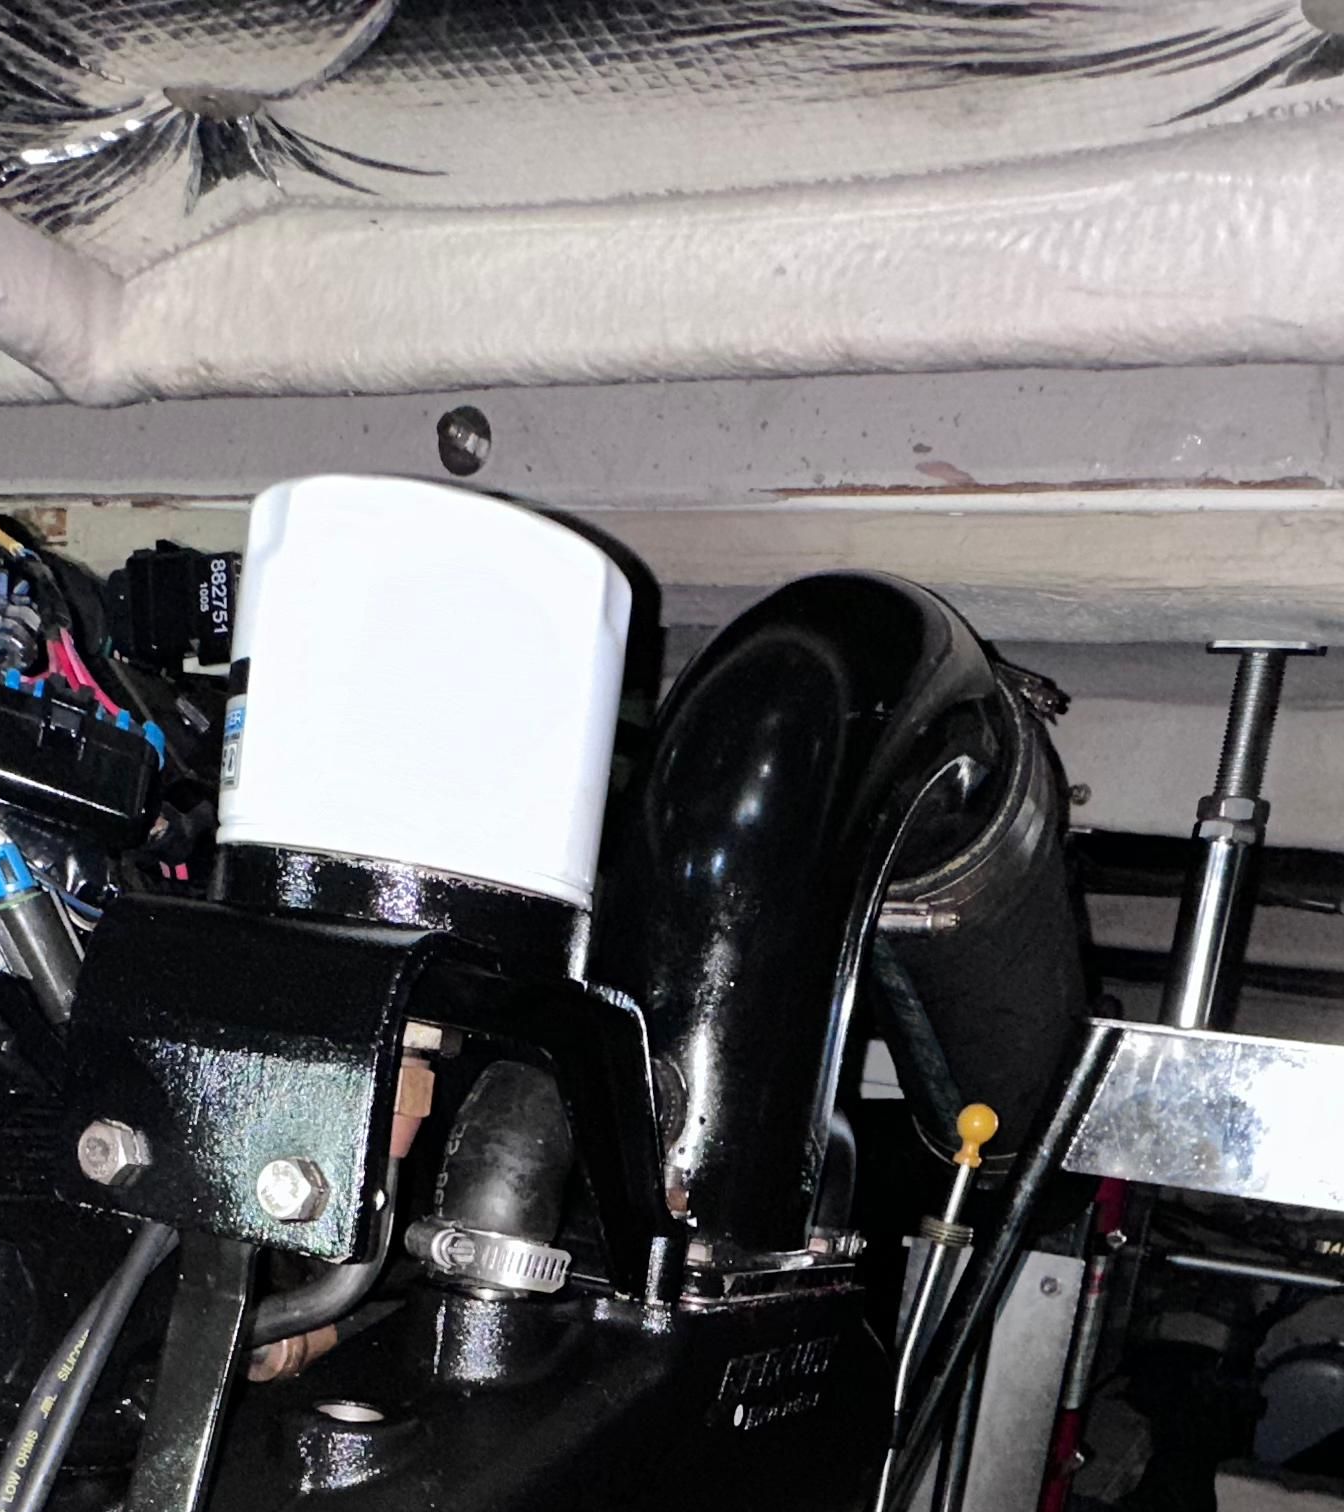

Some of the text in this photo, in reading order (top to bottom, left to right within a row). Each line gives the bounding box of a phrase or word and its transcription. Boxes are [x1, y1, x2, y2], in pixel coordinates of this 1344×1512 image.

[199, 582, 210, 613] 1005
[210, 559, 229, 634] 882751
[2, 1471, 21, 1503] LOW
[16, 1429, 39, 1468] OHMS
